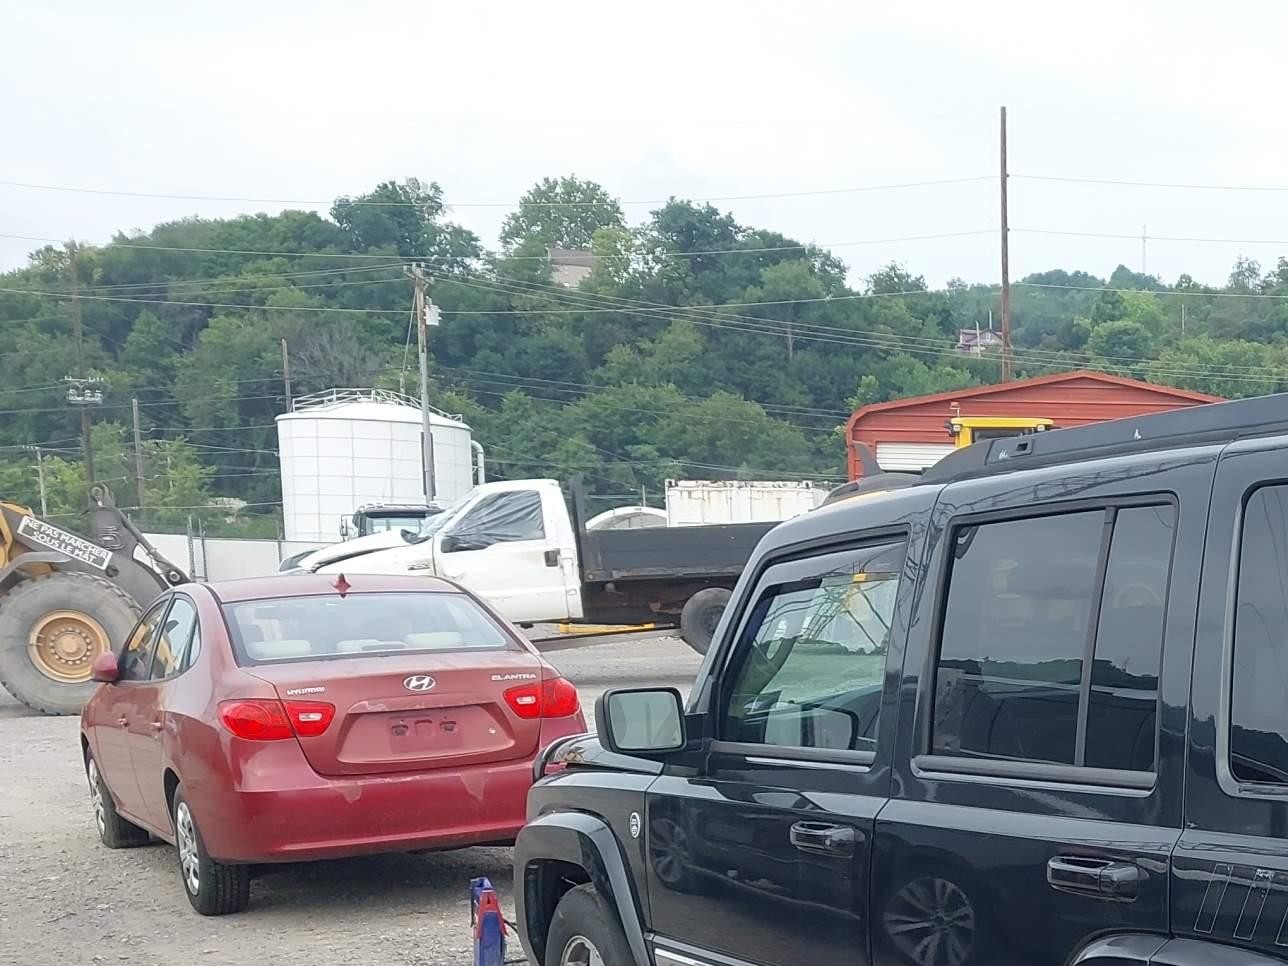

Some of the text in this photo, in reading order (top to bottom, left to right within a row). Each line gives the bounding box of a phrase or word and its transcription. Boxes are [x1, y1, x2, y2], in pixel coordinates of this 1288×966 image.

[32, 531, 59, 546] SOUS
[61, 543, 72, 552] LE
[40, 525, 58, 537] PAS
[60, 535, 107, 558] MARCHER
[491, 673, 537, 681] ELANTRA
